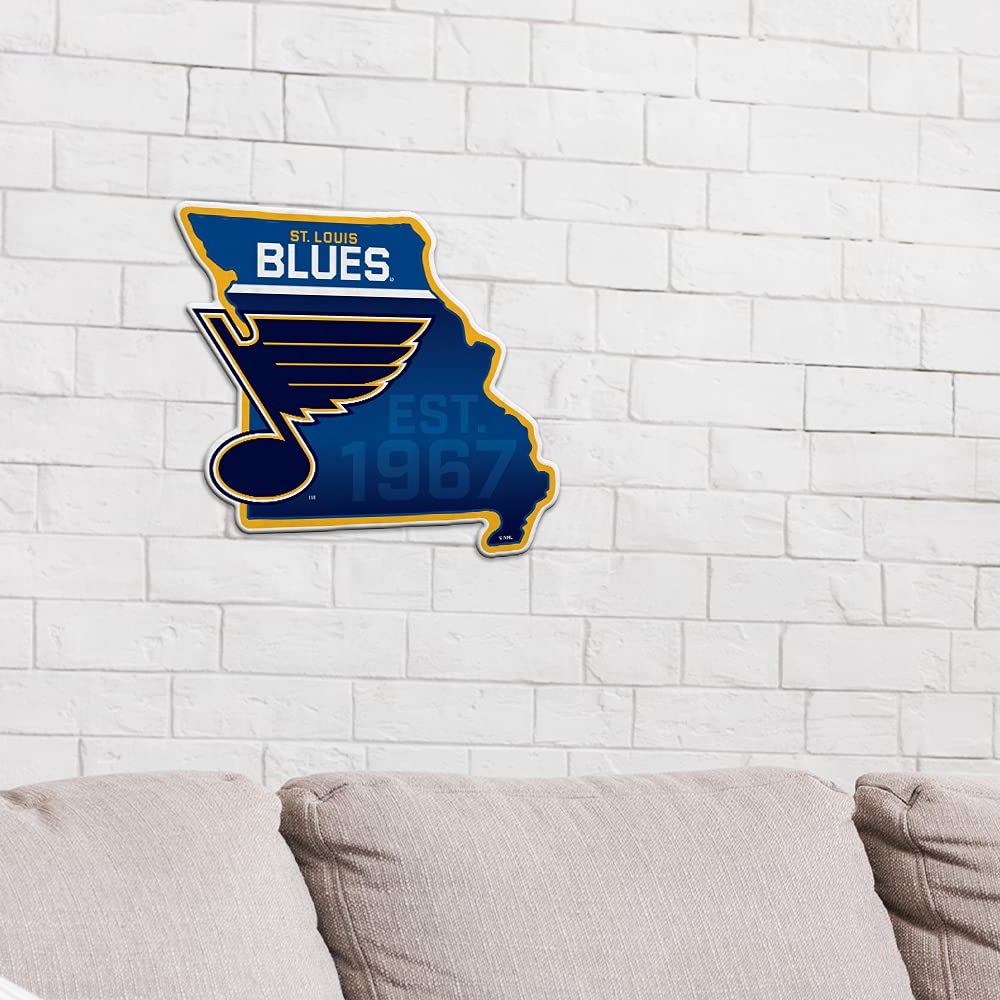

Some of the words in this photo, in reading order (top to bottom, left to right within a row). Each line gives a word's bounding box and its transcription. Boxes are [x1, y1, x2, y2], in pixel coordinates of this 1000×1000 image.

[290, 230, 310, 243] ST.
[314, 231, 358, 245] LOUIS
[256, 242, 390, 282] BLUES
[388, 394, 487, 434] EST.
[341, 438, 517, 503] 1967
